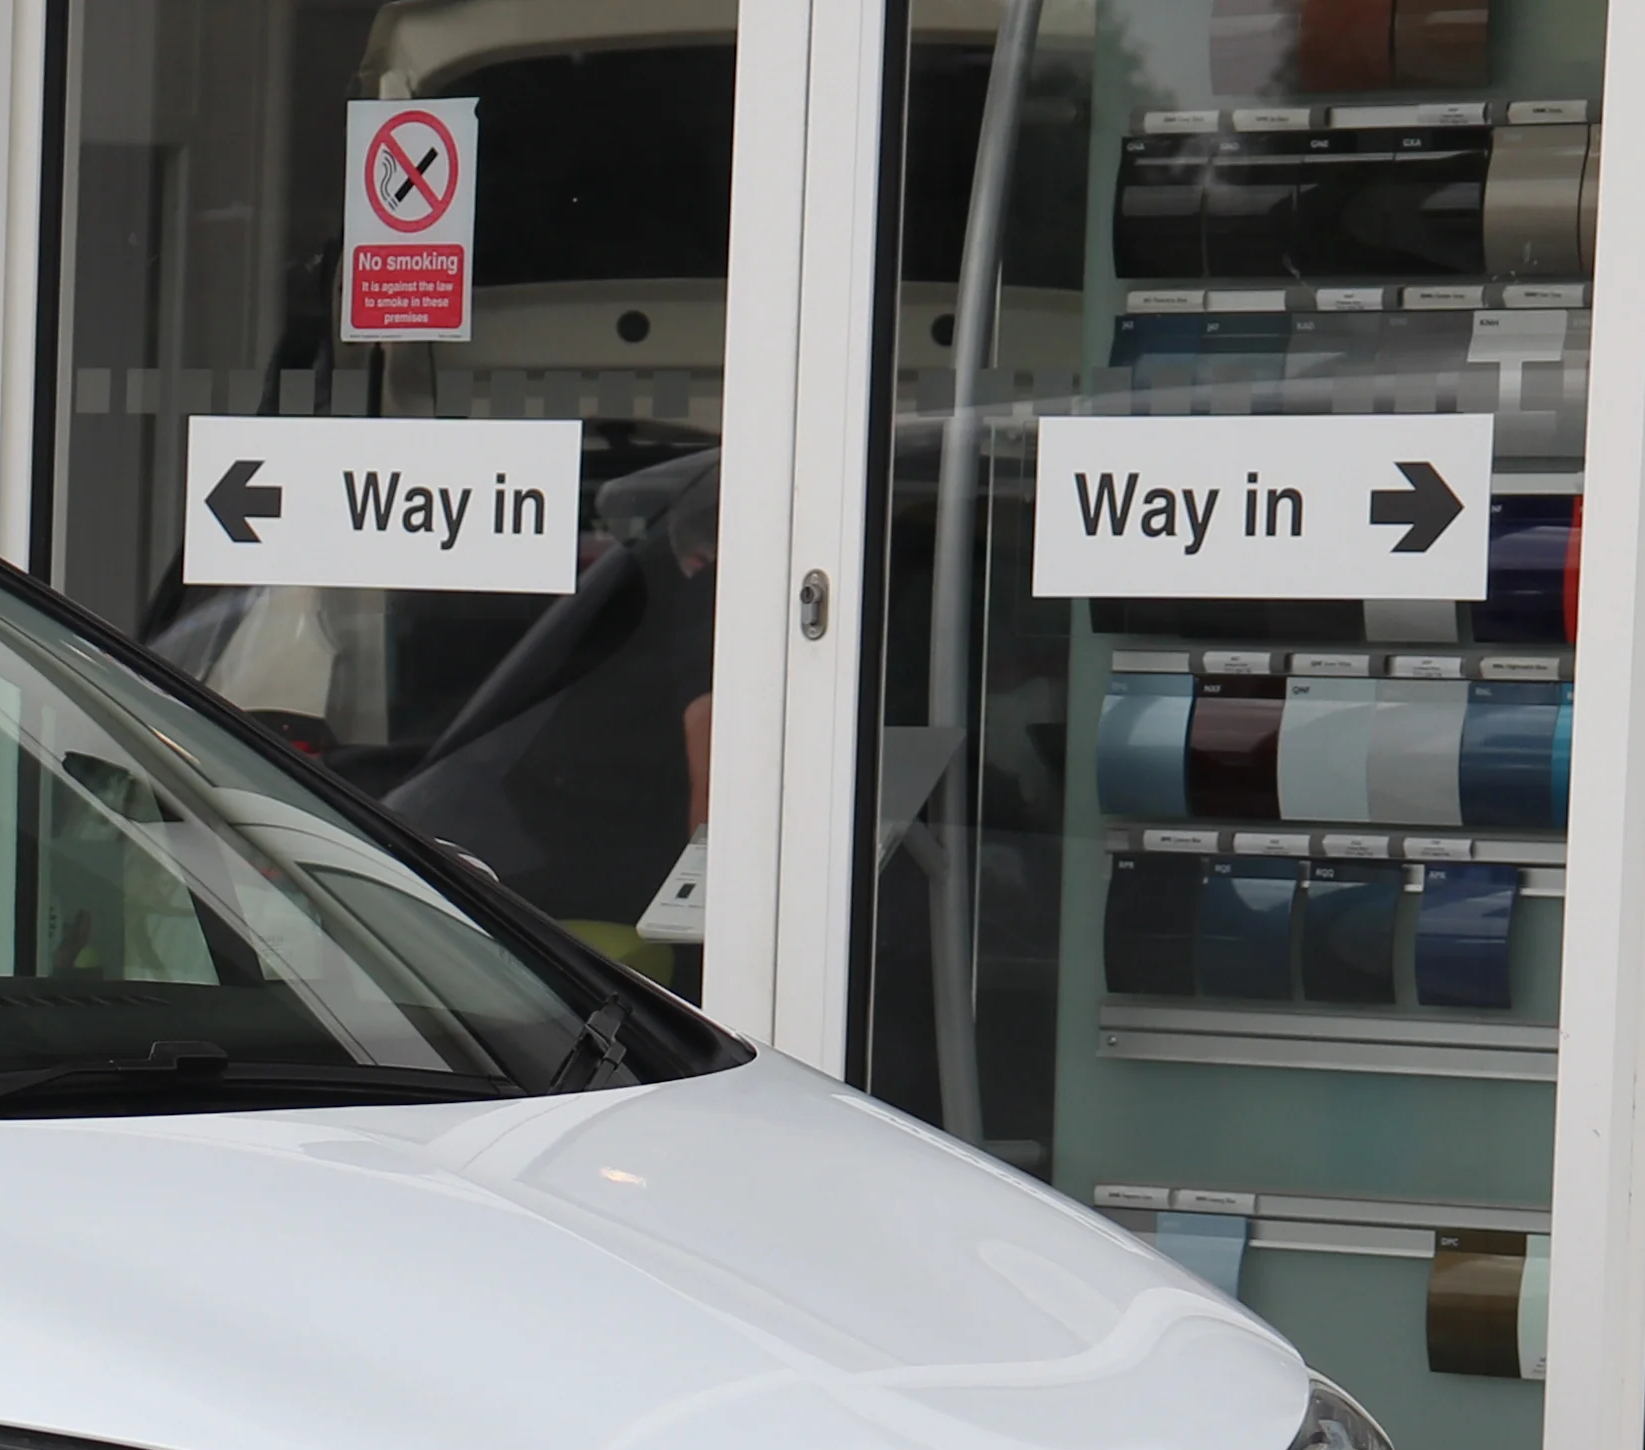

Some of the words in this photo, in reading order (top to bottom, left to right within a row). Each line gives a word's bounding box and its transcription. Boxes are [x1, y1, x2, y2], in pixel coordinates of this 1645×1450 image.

[358, 252, 382, 271] No
[386, 251, 458, 275] smoking
[361, 281, 370, 291] It
[371, 280, 379, 291] is
[381, 280, 417, 294] against
[419, 280, 434, 291] the
[436, 280, 454, 291] law
[365, 297, 375, 307] to
[377, 297, 409, 307] smoke
[411, 297, 420, 307] in
[422, 297, 449, 307] these
[384, 311, 428, 325] premises
[343, 471, 473, 550] Way
[493, 473, 545, 534] in
[1074, 472, 1220, 555] Way
[1245, 472, 1303, 537] in
